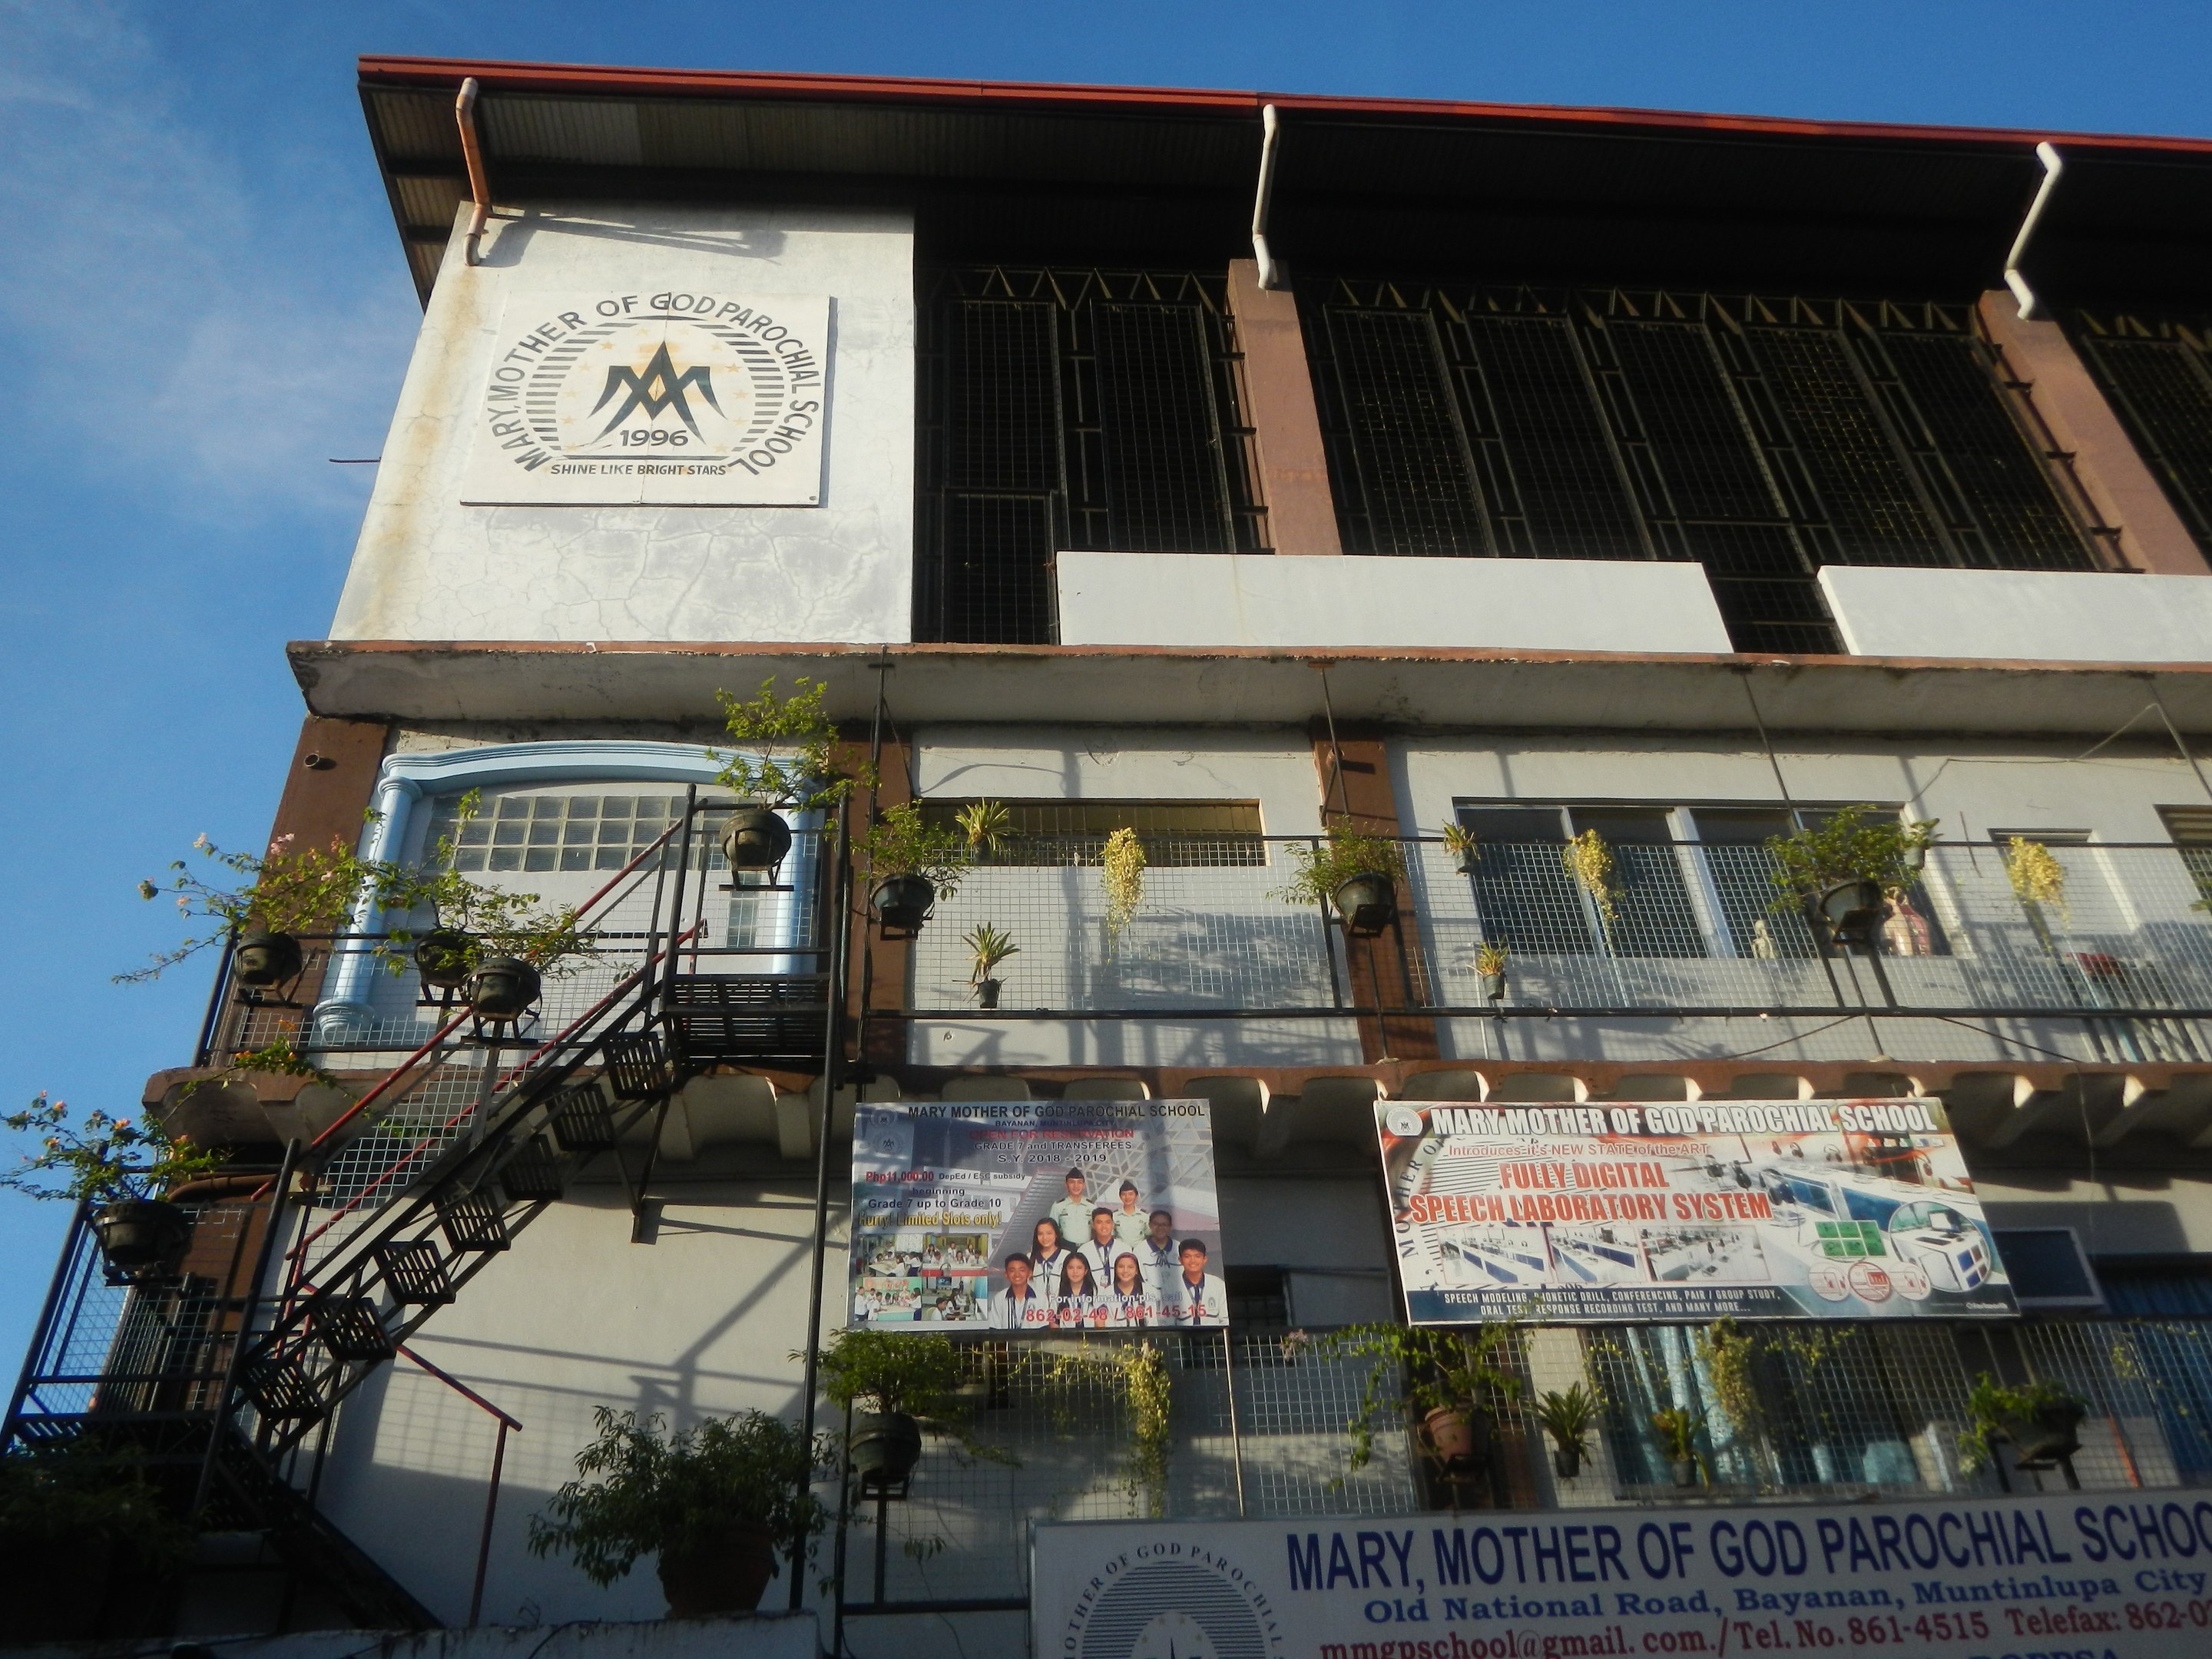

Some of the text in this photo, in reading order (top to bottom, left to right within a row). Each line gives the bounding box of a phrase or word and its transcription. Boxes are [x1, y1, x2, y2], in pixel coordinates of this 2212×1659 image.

[488, 293, 821, 475] MARY, MOTHER OF GOD PAROCHIAL SCHOOL
[619, 429, 689, 447] 1996
[550, 464, 727, 475] SHINE LIKE BRIGHT STARS
[909, 1107, 946, 1118] MARY
[951, 1106, 1008, 1118] MOTHER
[1012, 1106, 1030, 1117] OF
[1035, 1105, 1064, 1117] GOD
[1069, 1105, 1145, 1117] PAROCHIAL
[1150, 1105, 1205, 1117] SCHOOL
[1430, 1107, 1501, 1136] MARY
[1505, 1107, 1609, 1135] MOTHER
[1611, 1107, 1641, 1134] OF
[1645, 1107, 1699, 1135] GOD
[1698, 1106, 1839, 1134] PAROCHIAL
[1839, 1104, 1938, 1132] SCHOOL
[970, 1129, 1134, 1140] OPEN FOR RESERVATION
[975, 1141, 1132, 1151] GRADE 7 and TRANSFEREES
[1449, 1143, 1708, 1157] Introduces it's NEW STATE of the ART
[998, 1154, 1023, 1164] S.Y.
[1029, 1154, 1061, 1163] 2018
[1075, 1154, 1107, 1163] 2019
[939, 1173, 966, 1181] DepEd
[993, 1173, 1025, 1181] subsidy
[1498, 1161, 1671, 1190] FULLY DIGITAL
[912, 1187, 965, 1197] beginning
[869, 1198, 1002, 1211] Grade 7 up to Grade 10
[1409, 1191, 1773, 1224] SPEECH LABORATORY SYSTEM
[859, 1211, 1002, 1229] Hurry! Limited Slots only!
[1048, 1293, 1068, 1303] For
[1071, 1293, 1135, 1303] information
[1444, 1293, 1479, 1303] SPEECH
[1482, 1292, 1531, 1304] MODELING,
[1580, 1291, 1610, 1303] DRILL,
[1612, 1290, 1683, 1302] CONFERENCING,
[1685, 1290, 1706, 1300] PAIR
[1716, 1290, 1744, 1300] GROUP
[1748, 1289, 1780, 1300] STUDY,
[1026, 1307, 1108, 1323] 862-02-48
[1125, 1304, 1207, 1320] 861-45-15
[1480, 1305, 1504, 1316] ORAL
[1535, 1303, 1581, 1315] RESPONSE
[1584, 1303, 1634, 1313] RECORDING
[1637, 1303, 1663, 1313] TEST,
[1665, 1302, 1683, 1313] AND
[1686, 1302, 1711, 1313] MANY
[1286, 1528, 1426, 1594] MARY,
[1432, 1524, 1629, 1588] MOTHER
[1637, 1522, 1696, 1580] OF
[1709, 1518, 1808, 1578] GOD
[1816, 1508, 2073, 1575] PAROCHIAL
[1064, 1542, 1283, 1659] OTHER OF GOD PAROCHIAL
[1364, 1568, 2207, 1624] Old National Road, Bayanan, Muntinlupa City
[2005, 1604, 2122, 1637] Telefax:
[2124, 1598, 2212, 1631] 862-0
